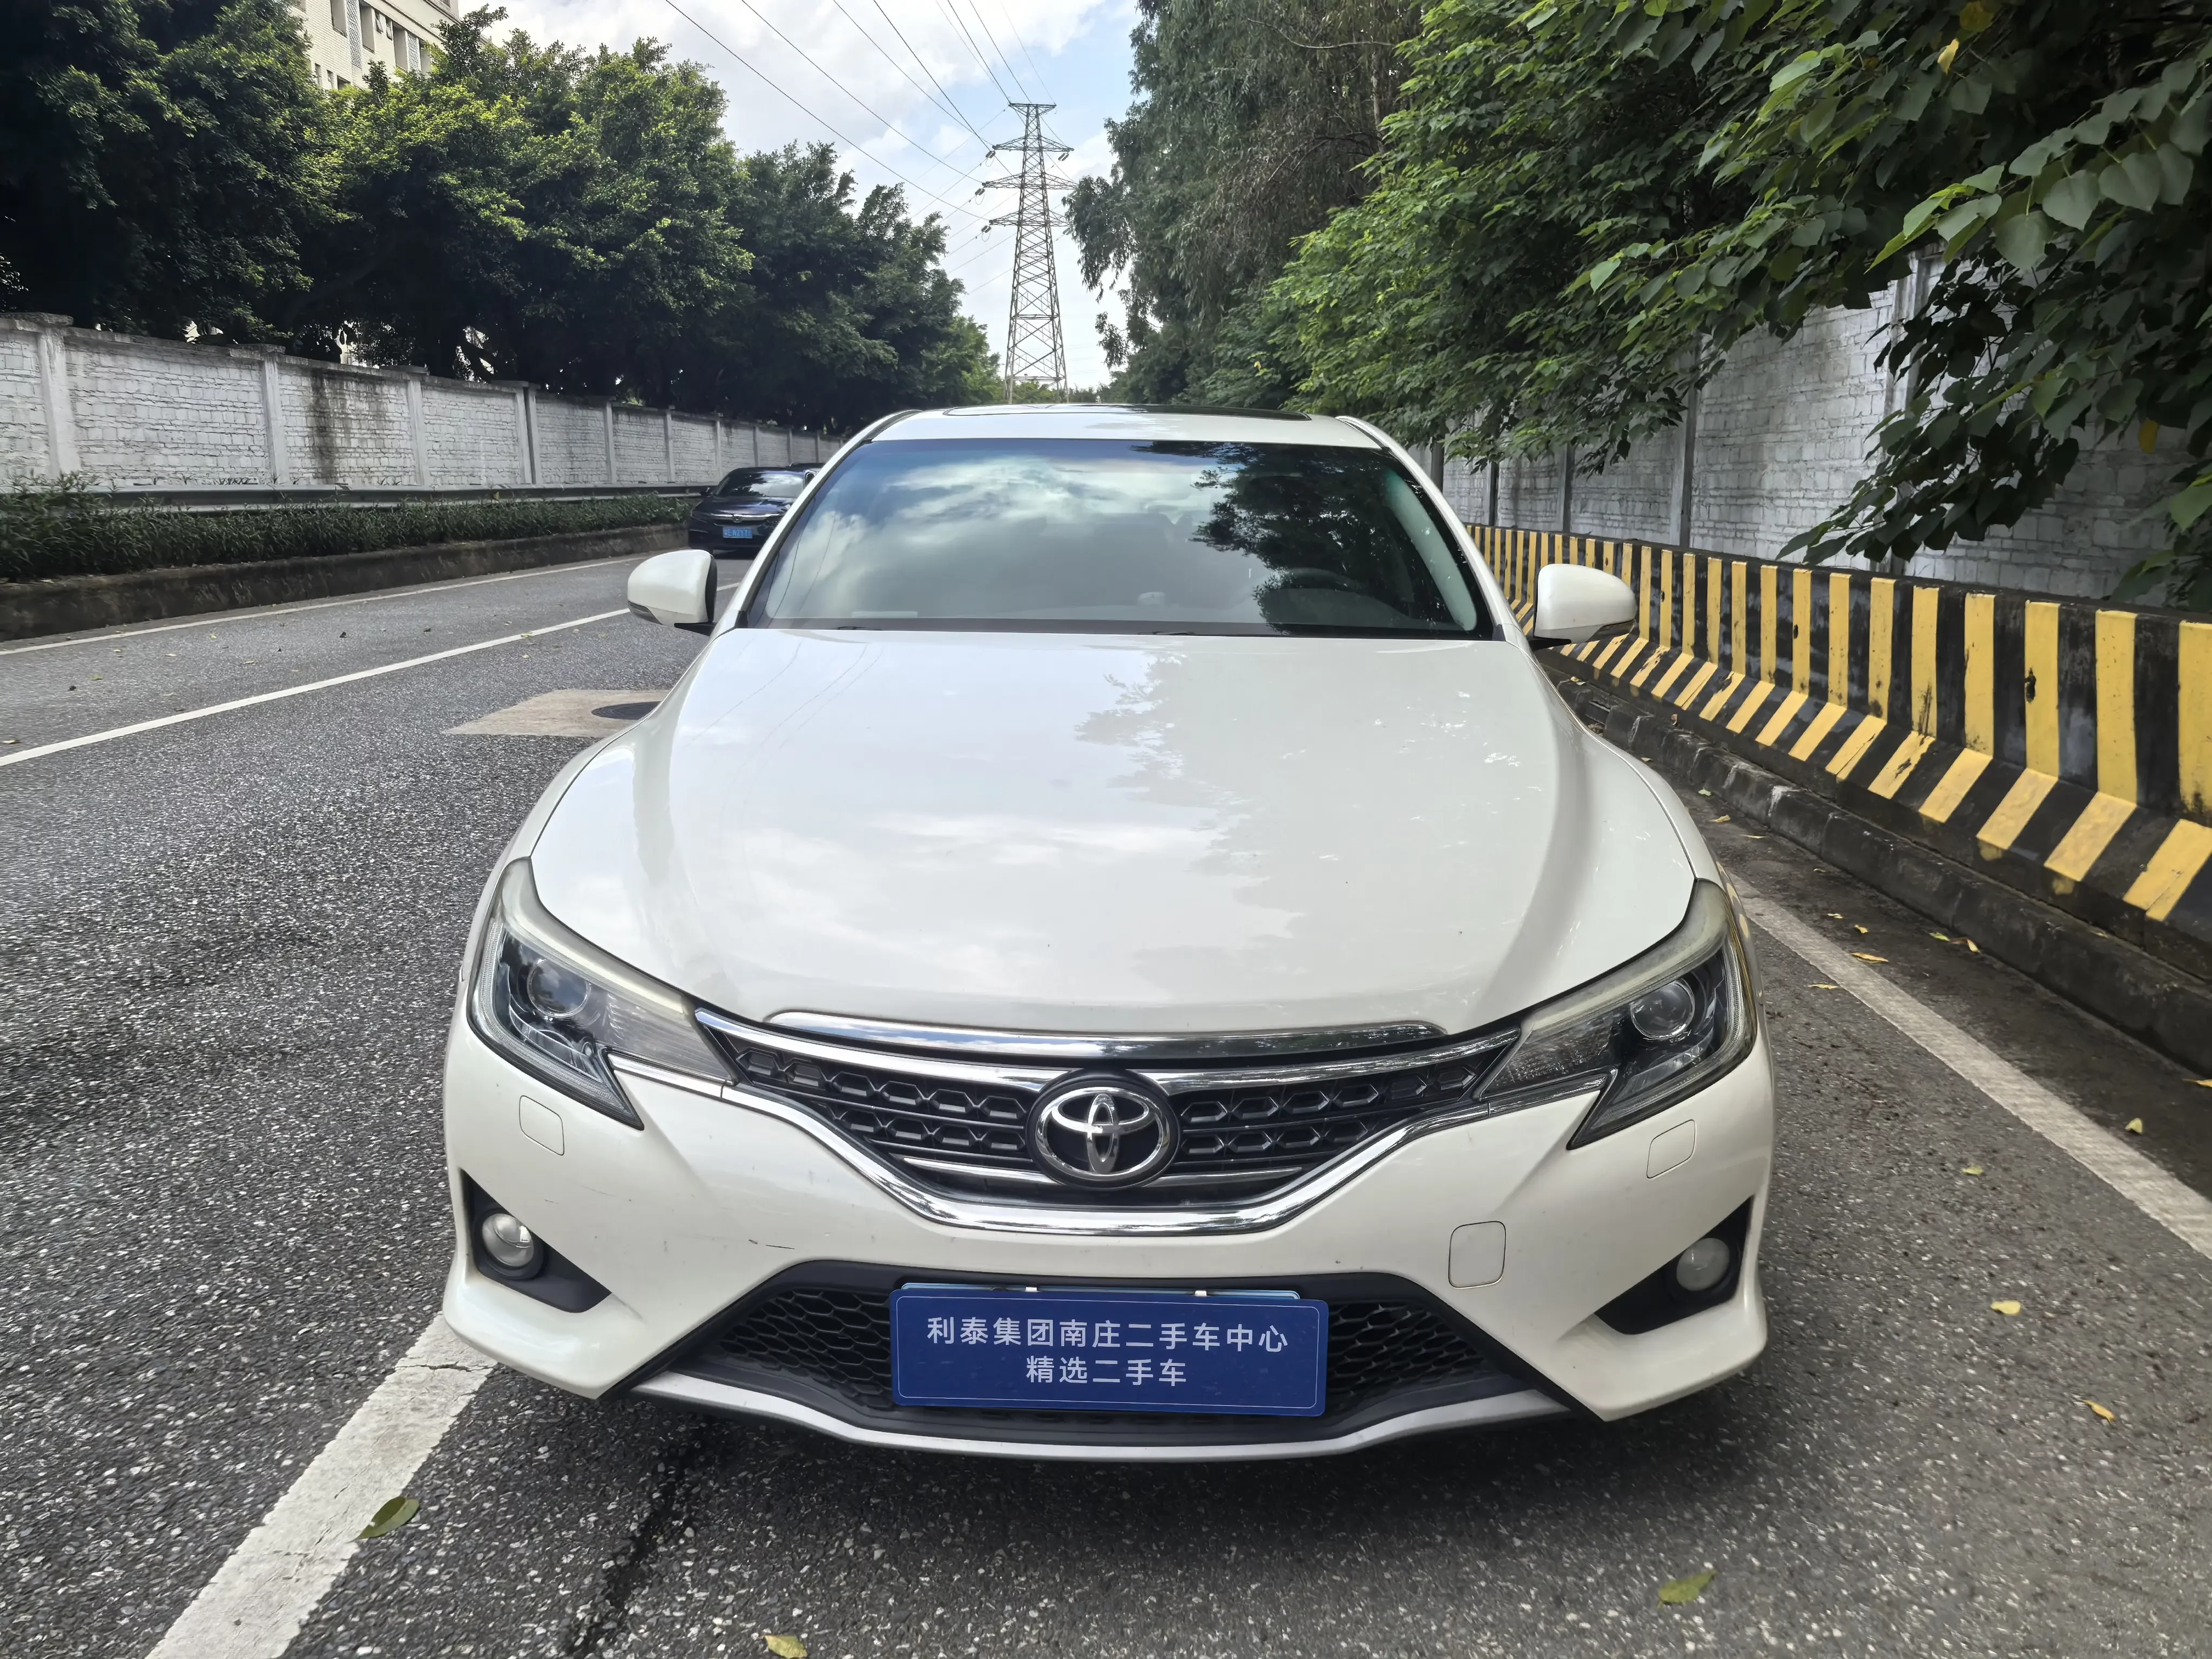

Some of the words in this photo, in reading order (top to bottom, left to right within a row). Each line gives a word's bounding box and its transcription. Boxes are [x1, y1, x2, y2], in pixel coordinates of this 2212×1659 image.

[927, 1317, 1289, 1353] 利泰集团南庄二手车中心
[1026, 1355, 1187, 1387] 精选二手车
